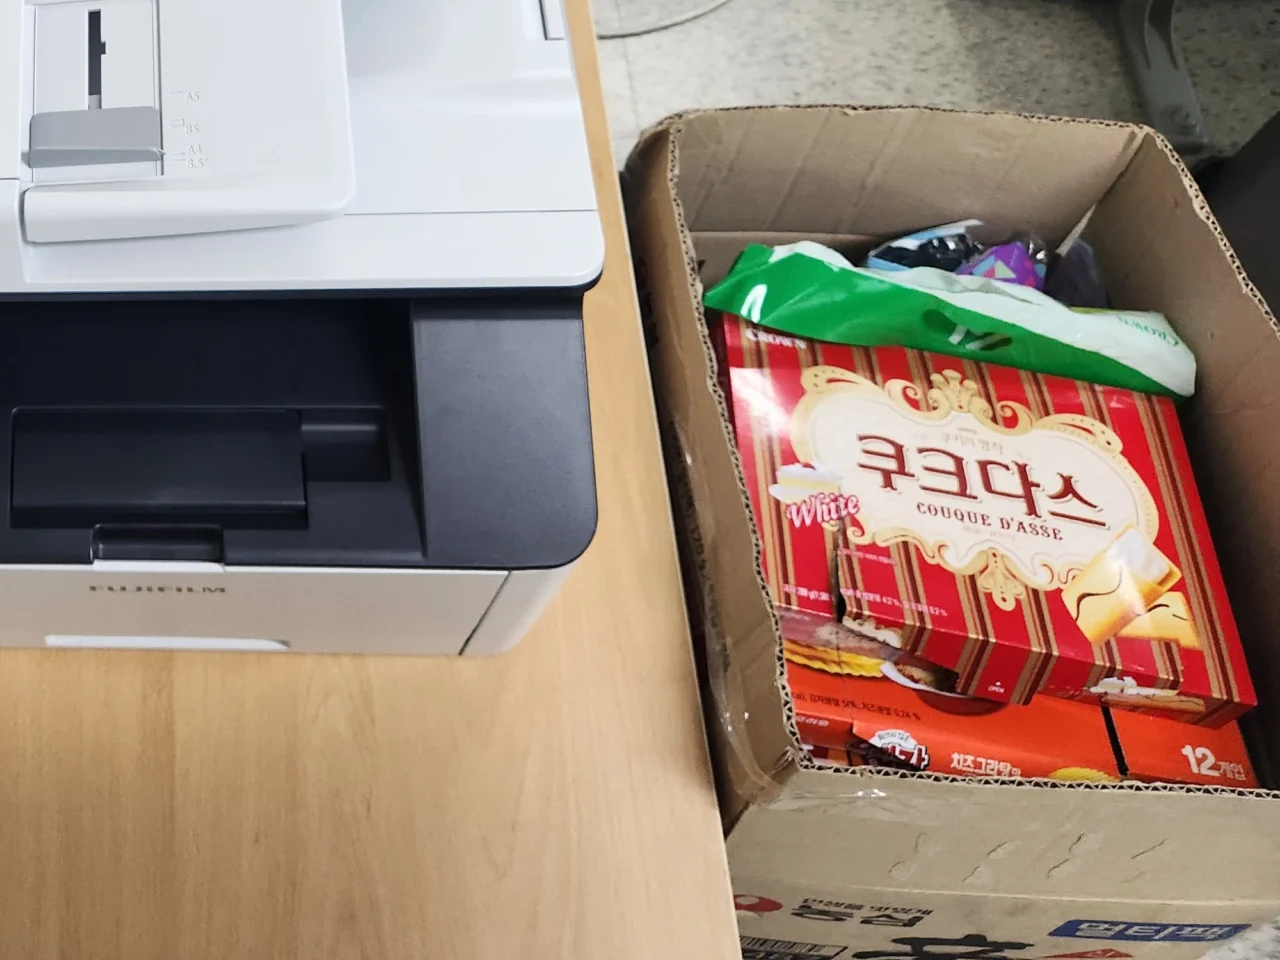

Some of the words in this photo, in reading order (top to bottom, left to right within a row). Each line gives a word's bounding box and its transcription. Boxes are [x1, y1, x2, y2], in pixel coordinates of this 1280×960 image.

[856, 434, 1106, 527] 쿠크다스
[786, 492, 860, 529] White
[916, 501, 992, 527] COUQUE
[1000, 517, 1064, 541] D'ASSE
[89, 585, 226, 593] FUJIFILM
[1181, 744, 1247, 781] 12개입
[791, 905, 925, 927] 농심
